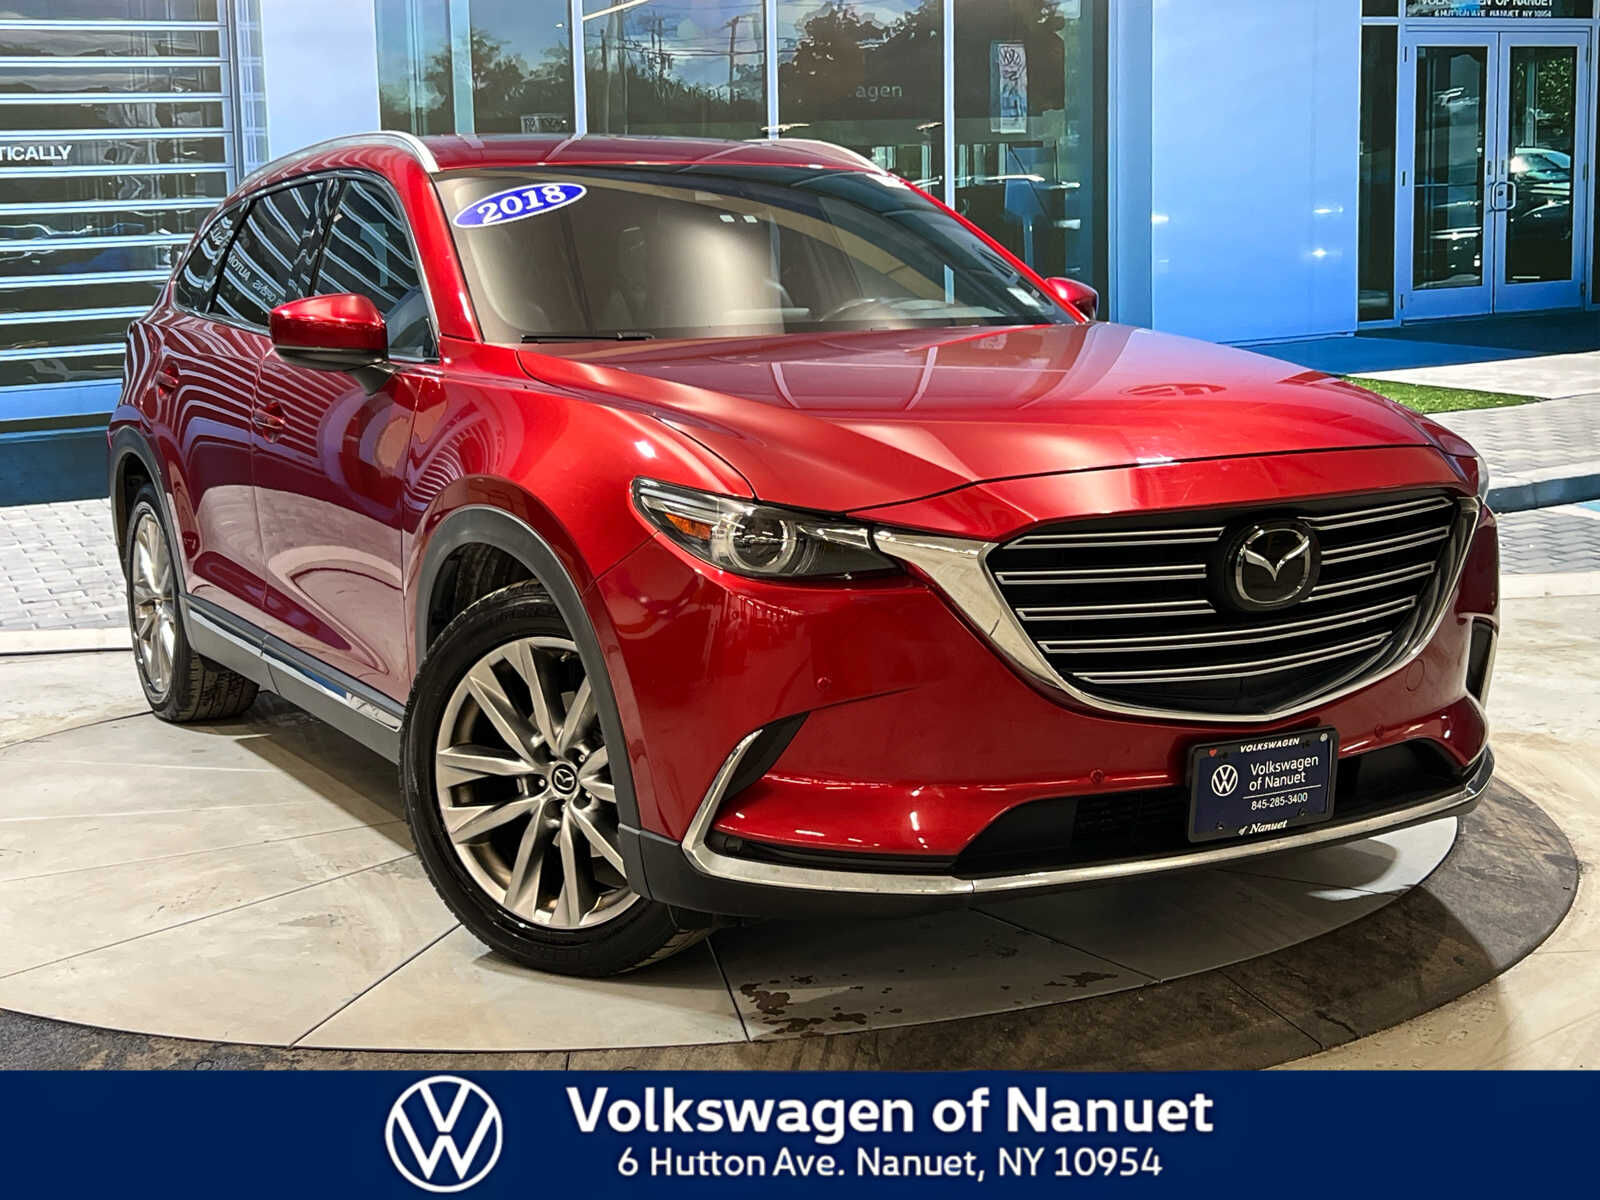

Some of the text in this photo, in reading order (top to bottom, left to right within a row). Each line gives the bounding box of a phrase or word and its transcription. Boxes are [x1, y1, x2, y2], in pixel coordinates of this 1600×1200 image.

[477, 184, 566, 225] 2018
[1239, 737, 1301, 753] VOLKSWAGEN
[1250, 755, 1319, 776] Volkswagen
[1249, 770, 1307, 792] of Nanuet
[1250, 791, 1308, 811] 845-285-3400
[1249, 819, 1288, 834] Nanuet
